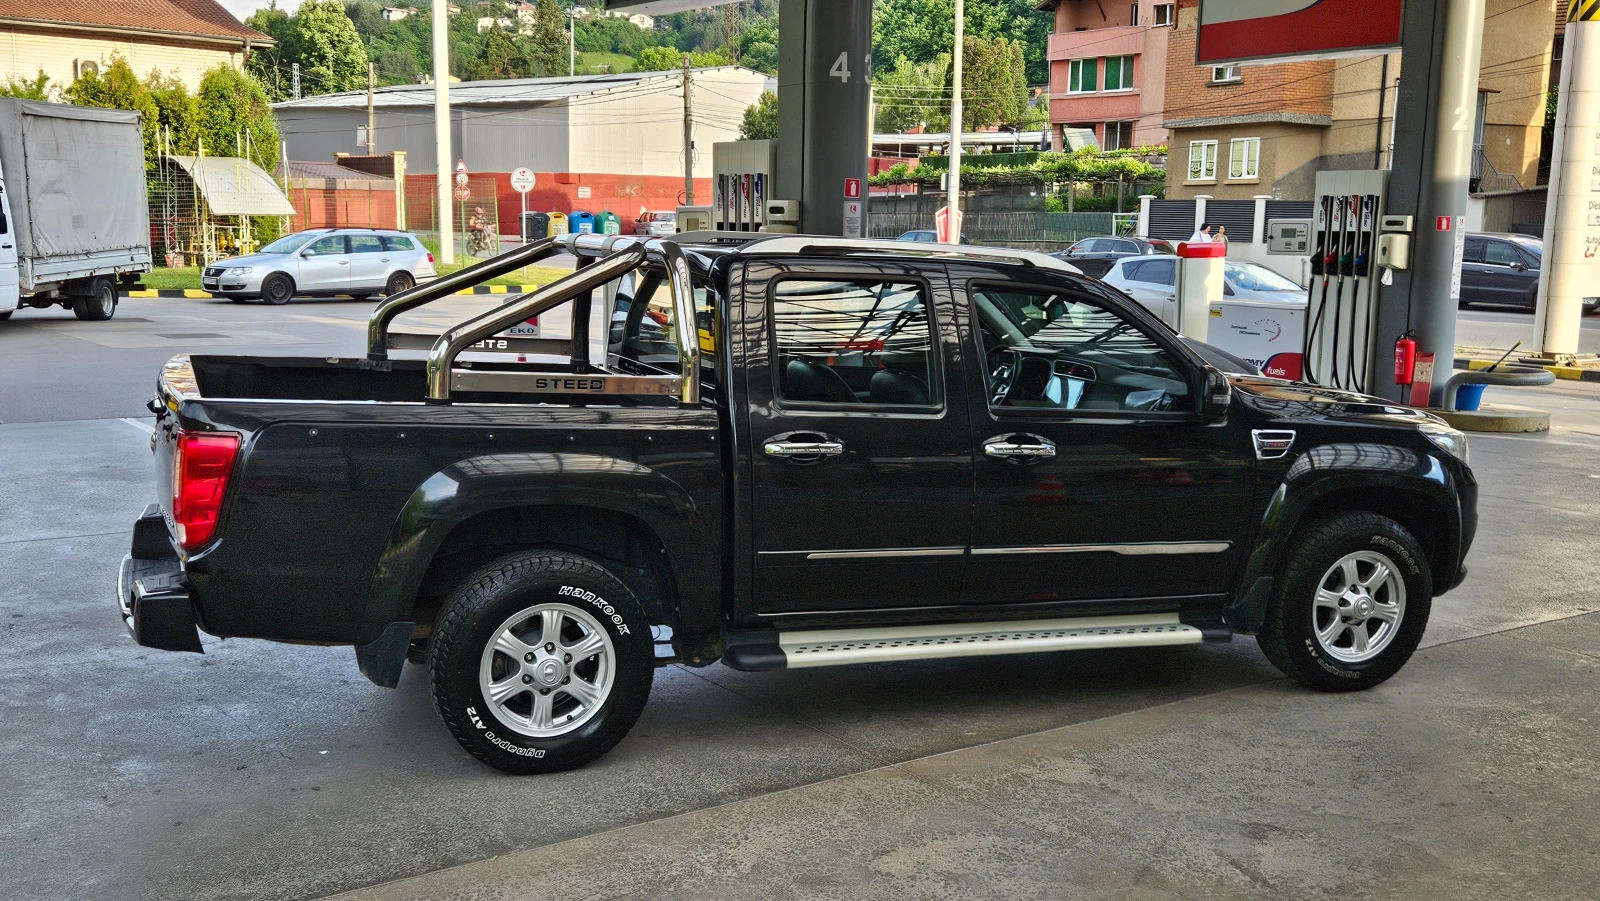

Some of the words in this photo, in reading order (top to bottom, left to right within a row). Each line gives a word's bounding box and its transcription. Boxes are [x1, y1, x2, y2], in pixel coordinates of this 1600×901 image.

[829, 51, 851, 83] 4
[1452, 106, 1469, 131] 2
[1266, 366, 1286, 376] fuels
[535, 378, 604, 391] STEED
[466, 706, 487, 730] AT2
